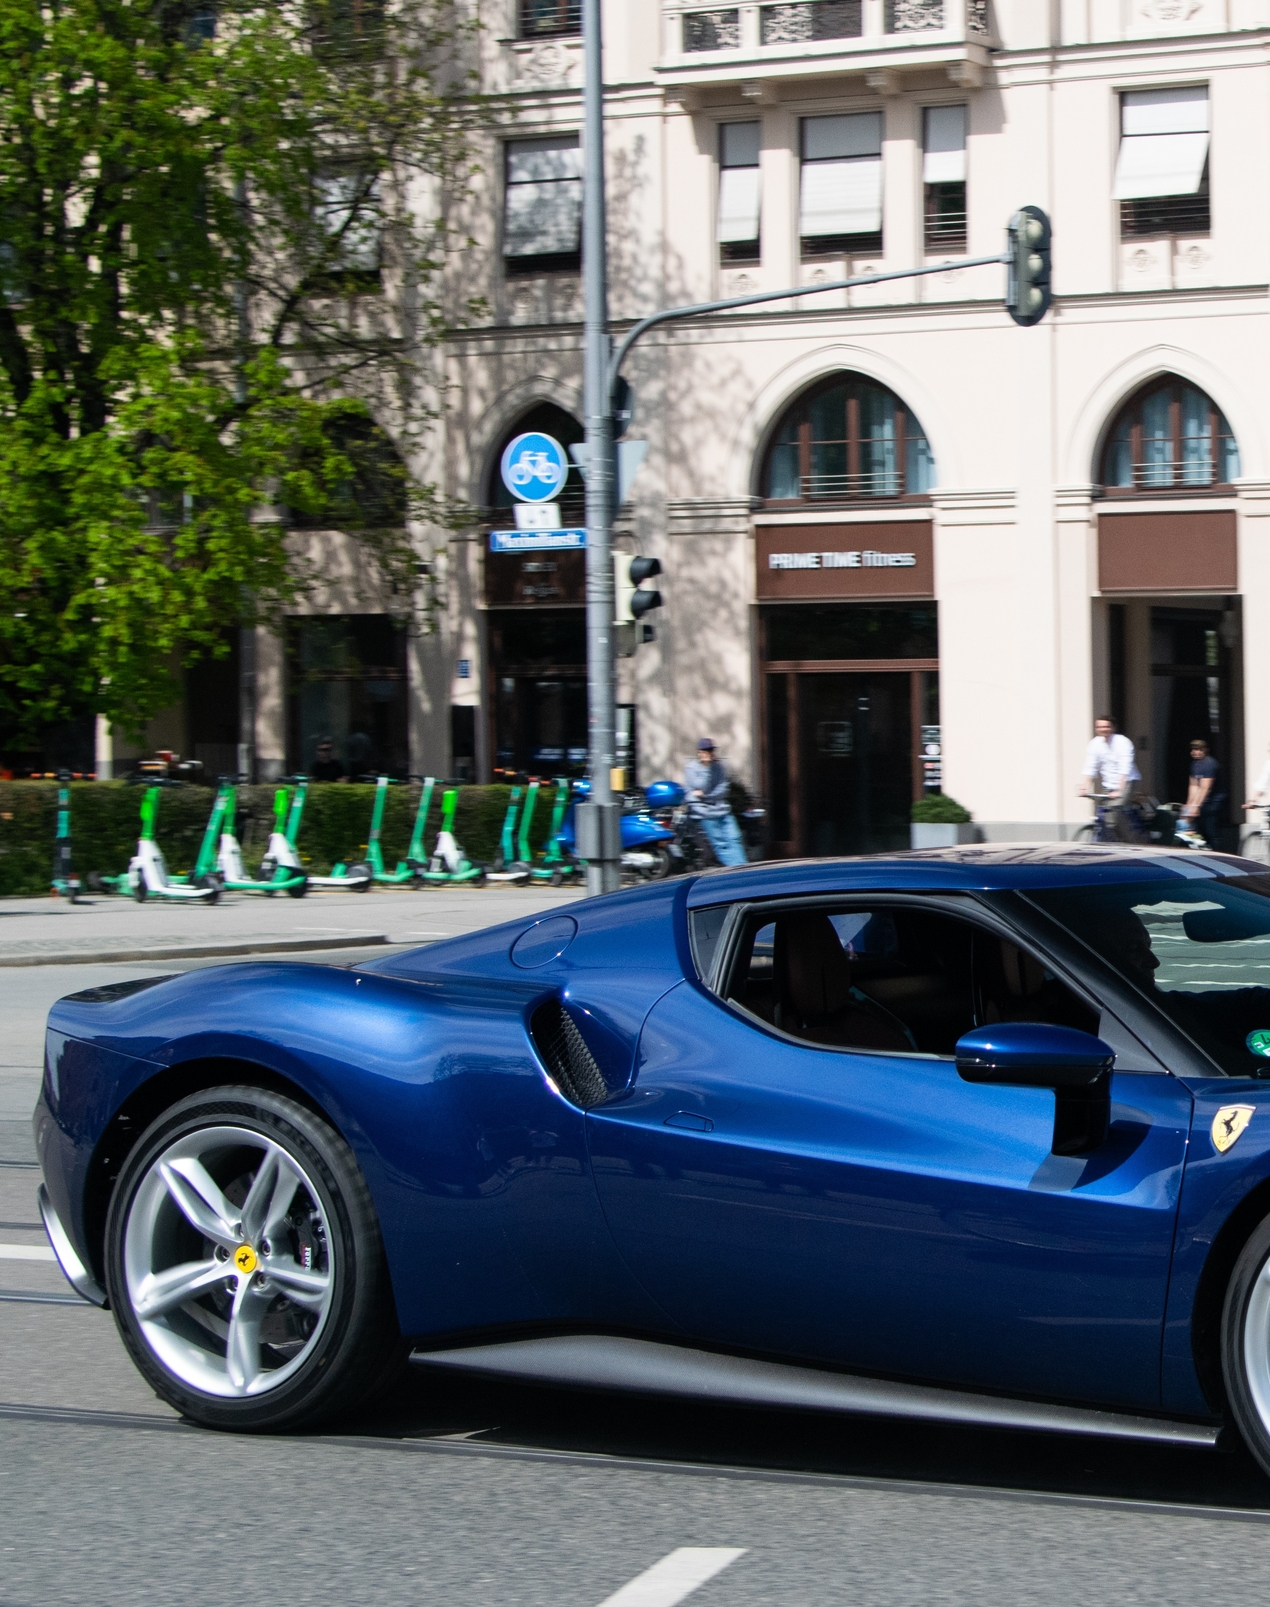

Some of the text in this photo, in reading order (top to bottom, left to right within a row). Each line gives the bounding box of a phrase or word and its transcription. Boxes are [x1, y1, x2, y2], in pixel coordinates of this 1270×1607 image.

[769, 550, 917, 570] PRIME TIME fitness
